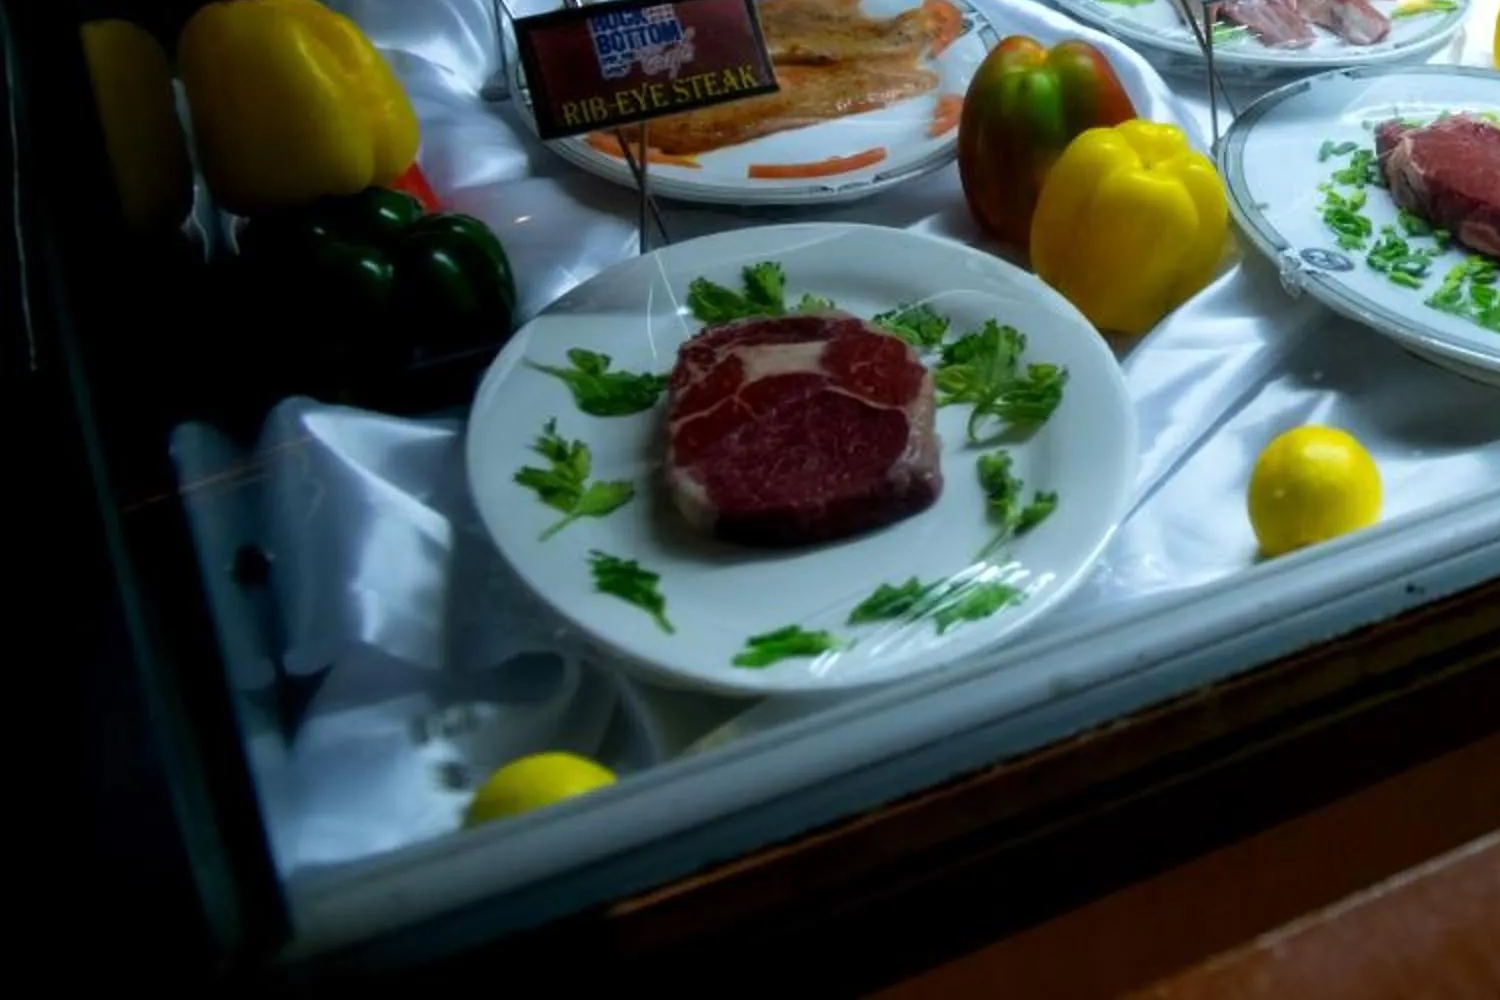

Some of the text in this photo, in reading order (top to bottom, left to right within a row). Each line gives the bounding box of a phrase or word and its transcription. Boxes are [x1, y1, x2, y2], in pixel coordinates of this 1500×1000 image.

[597, 20, 681, 54] BOTTOM
[561, 84, 669, 128] RIB-EYE
[672, 62, 760, 104] STEAK
